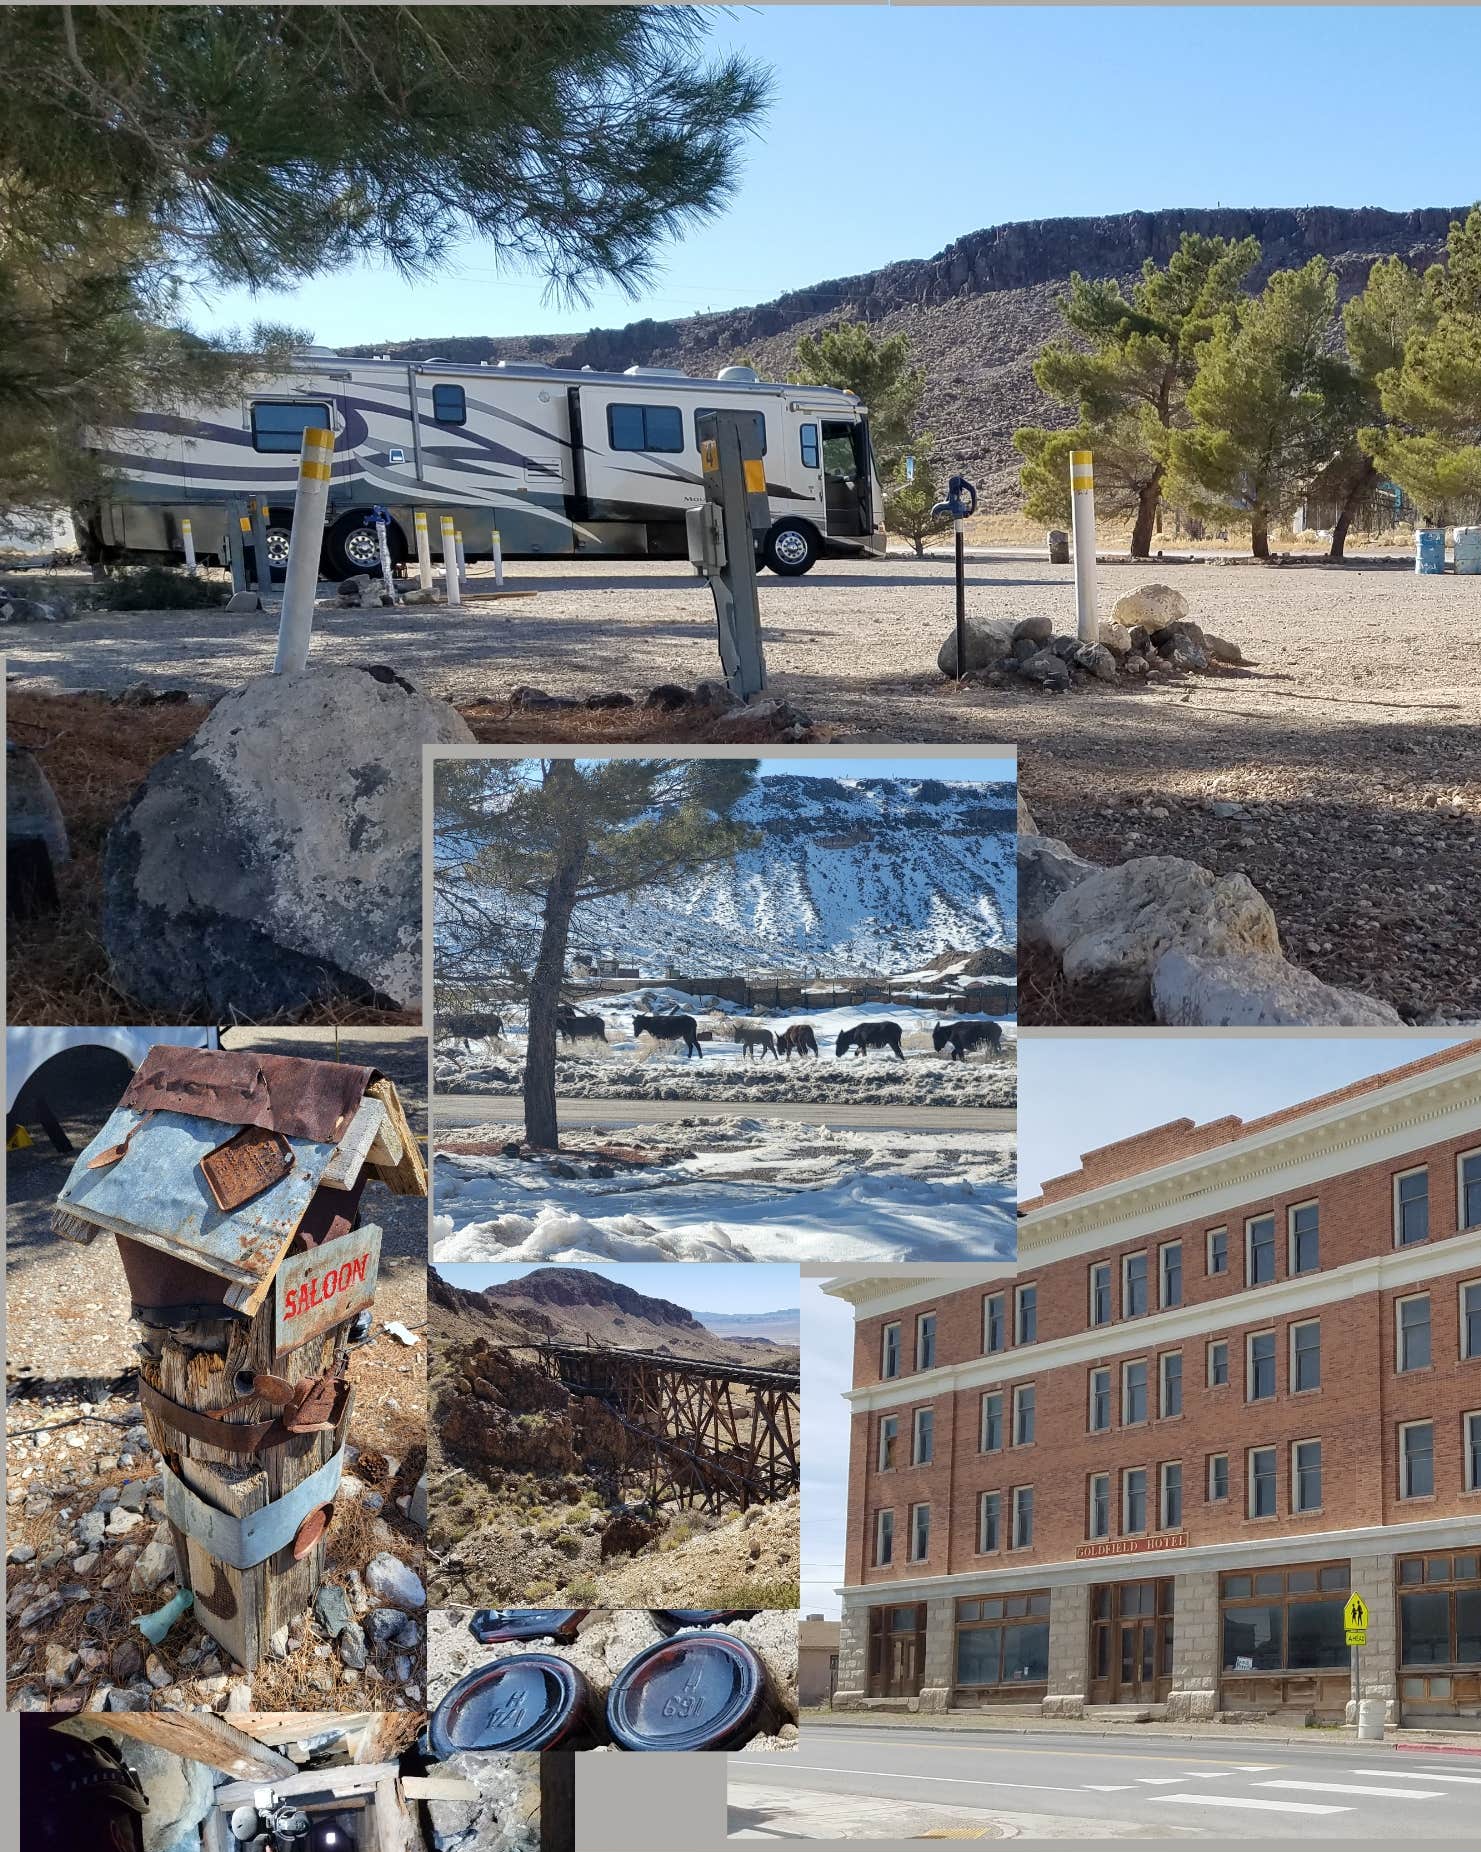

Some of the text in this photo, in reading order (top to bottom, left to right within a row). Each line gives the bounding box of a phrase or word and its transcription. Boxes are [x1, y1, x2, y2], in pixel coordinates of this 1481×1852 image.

[283, 1253, 370, 1321] SALOON
[1077, 1534, 1186, 1557] GOLDFIELD HOTEL
